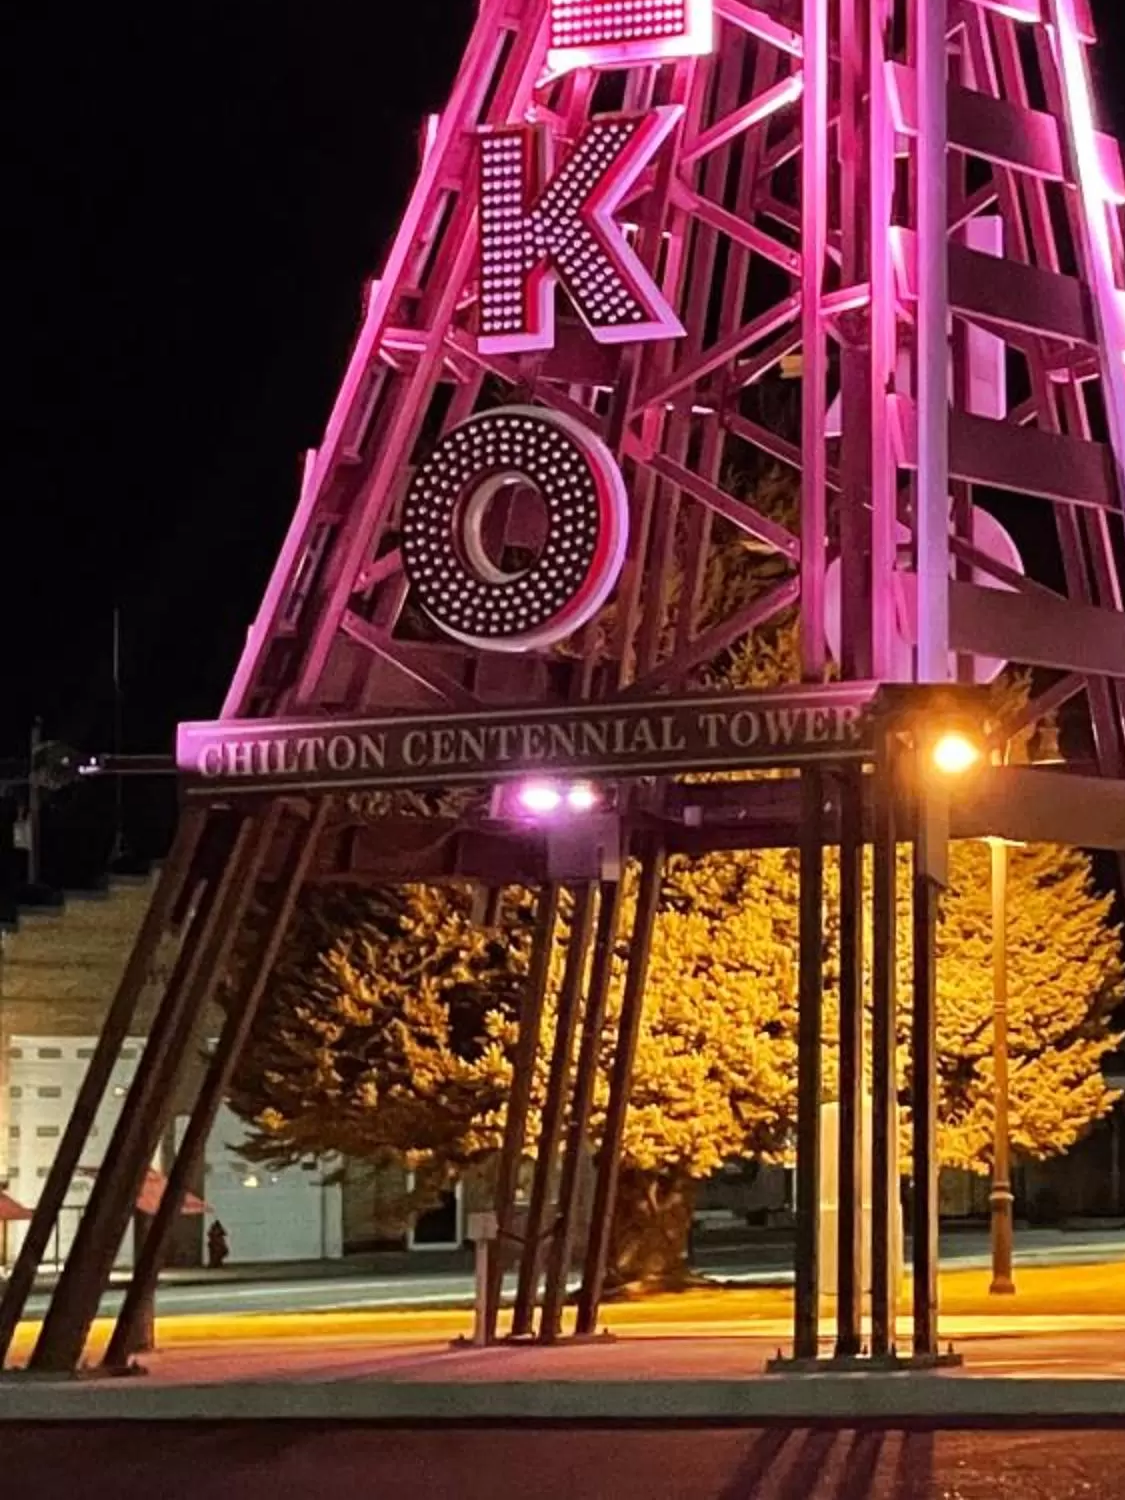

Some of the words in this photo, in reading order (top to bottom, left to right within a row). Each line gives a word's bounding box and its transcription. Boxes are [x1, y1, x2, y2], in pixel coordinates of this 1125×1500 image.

[198, 732, 388, 777] CHILTON
[402, 714, 686, 767] CENTENNIAL
[698, 704, 861, 748] TOWER
